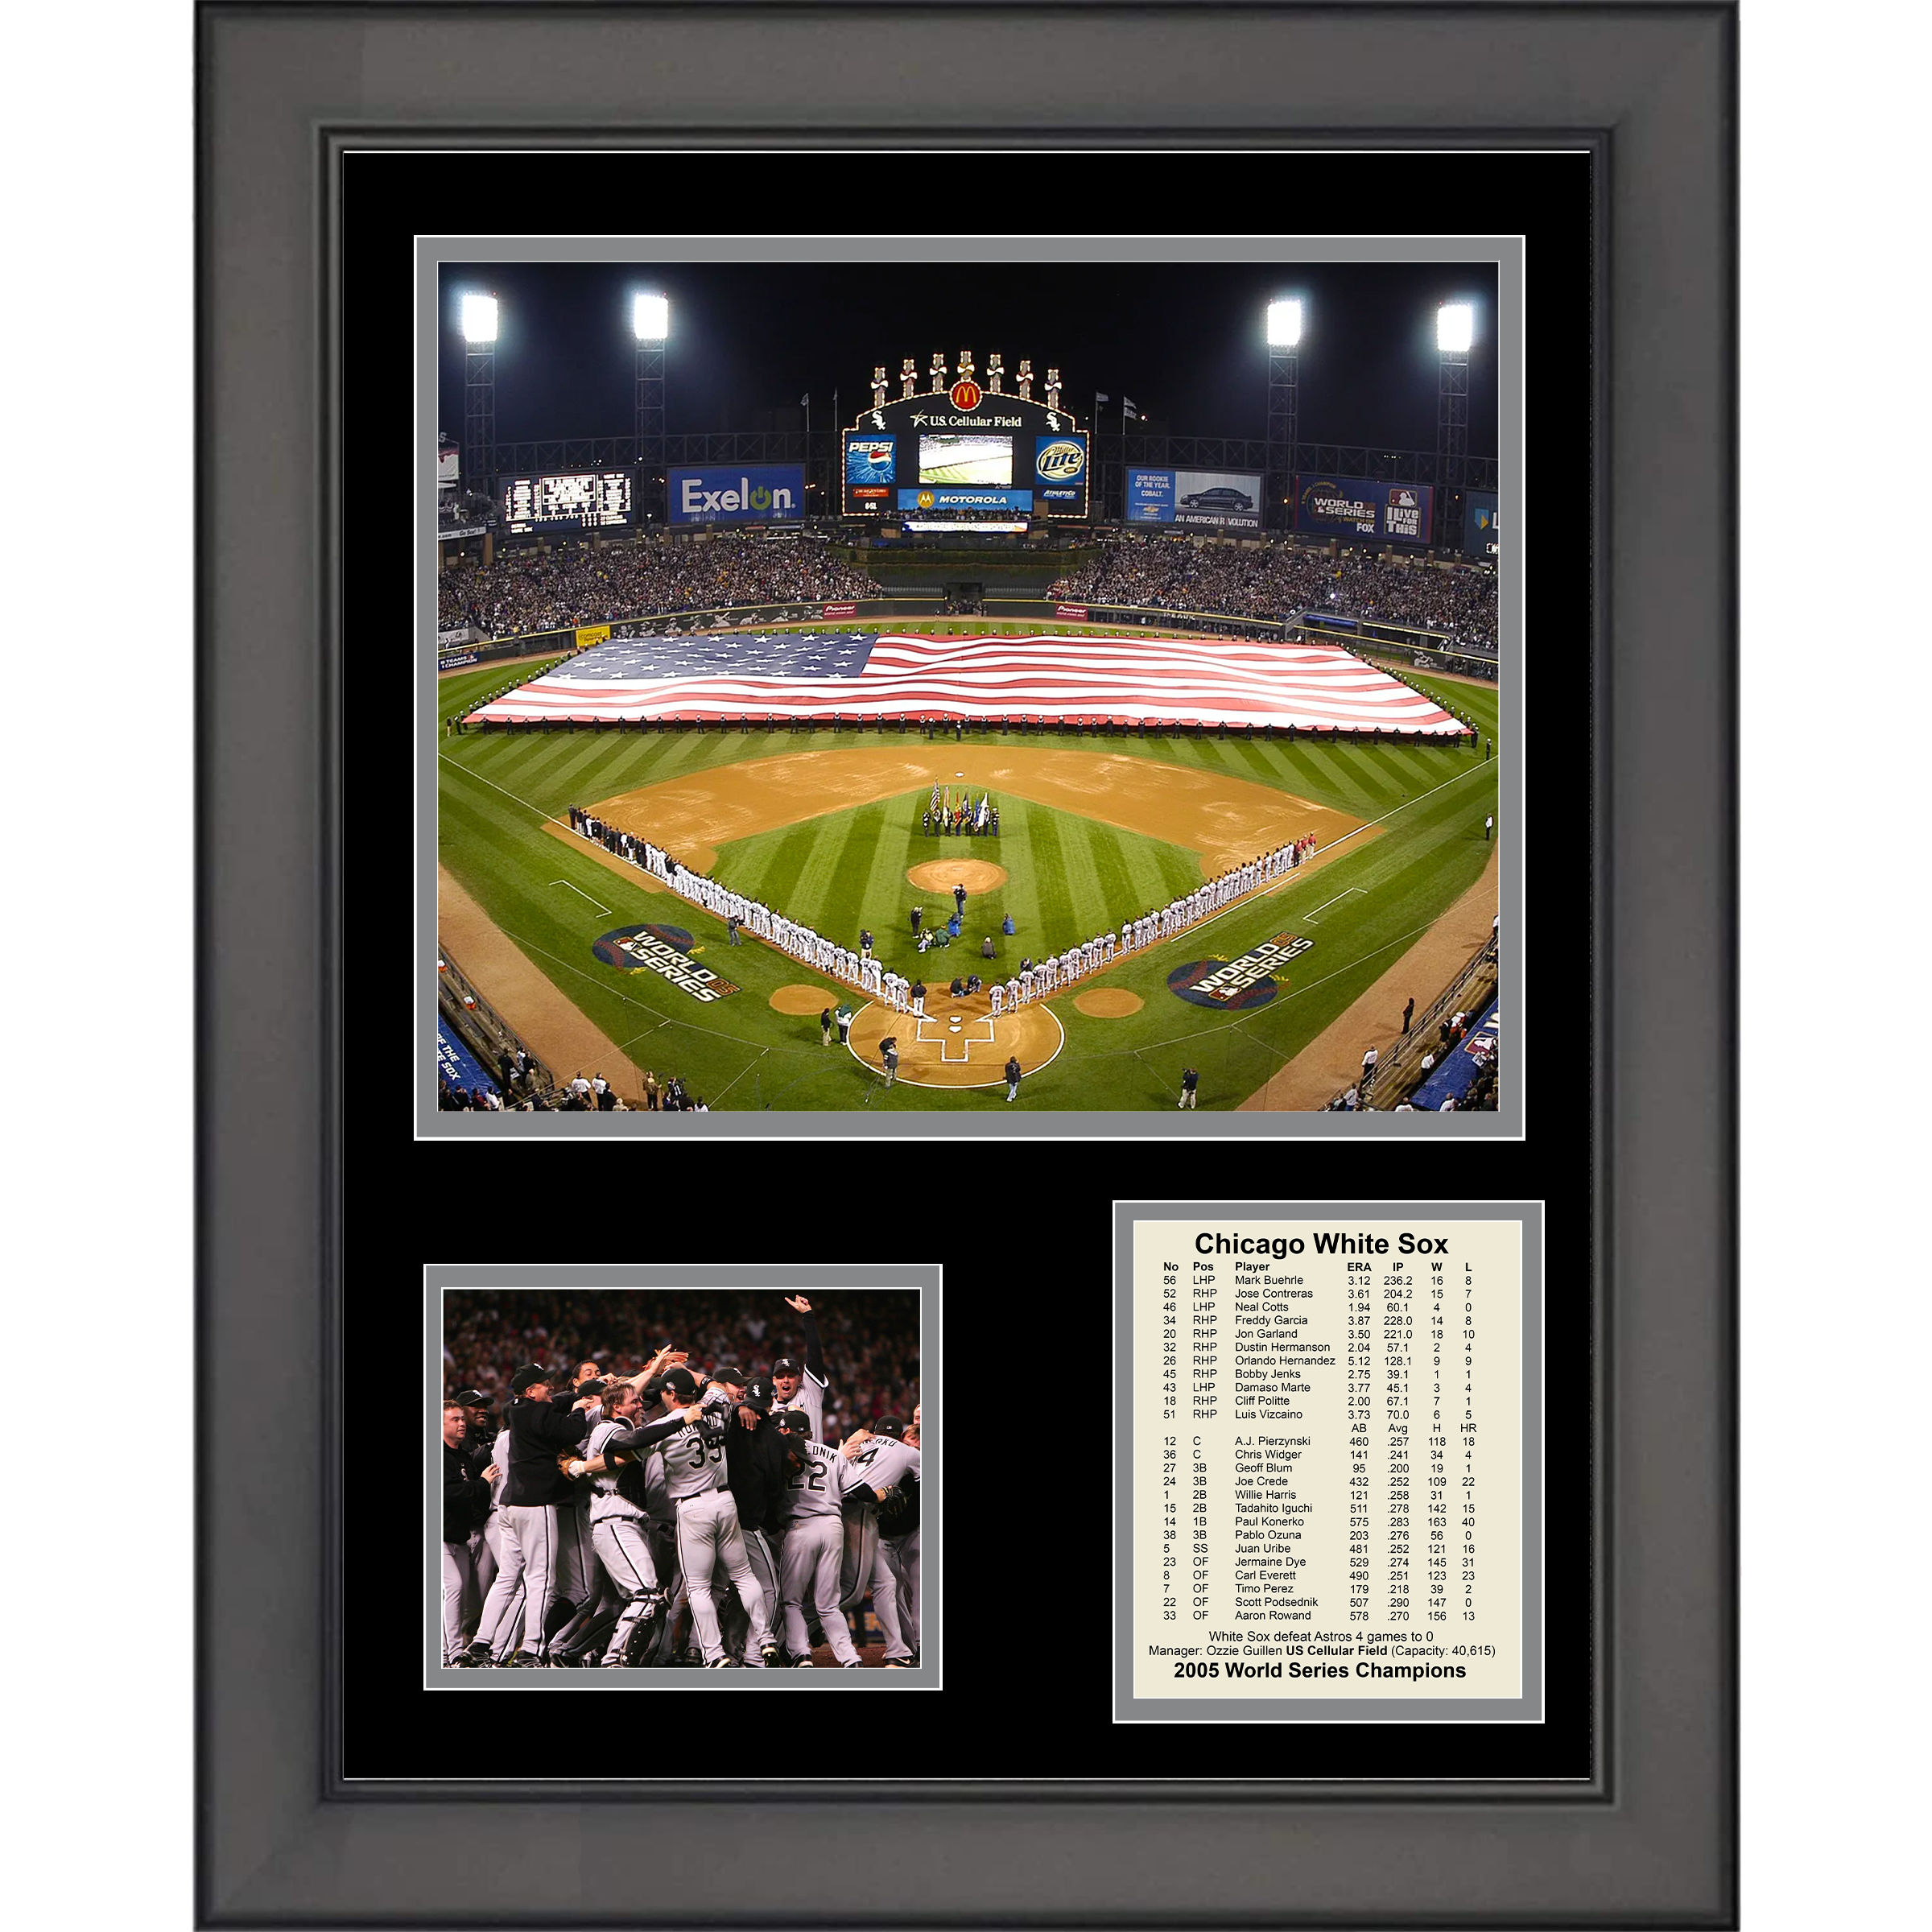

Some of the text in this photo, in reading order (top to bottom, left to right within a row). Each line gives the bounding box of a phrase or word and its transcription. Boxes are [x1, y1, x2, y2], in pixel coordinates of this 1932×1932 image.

[930, 415, 1022, 427] U.S. Cellular Field
[848, 442, 894, 452] PEPSI
[1042, 452, 1081, 472] Lite
[682, 477, 791, 513] Exelon
[939, 495, 1007, 504] MOTOROLA
[1314, 497, 1364, 510] WORLD
[1325, 506, 1375, 519] SERIES
[1174, 514, 1185, 522] AN
[1185, 515, 1218, 525] AMERICAN
[1356, 522, 1375, 533] FOX
[1057, 605, 1087, 613] Pioneer
[445, 658, 477, 668] CHAMPION
[633, 931, 718, 983] WORLD
[1190, 943, 1281, 993] WORLD
[1230, 938, 1315, 989] SERIES
[630, 948, 721, 1002] SERIES
[443, 1044, 460, 1063] THE
[441, 1062, 461, 1080] SOX
[1195, 1232, 1449, 1260] Chicago White Sox
[1163, 1261, 1472, 1274] No Pos Player ERA IP W L
[1163, 1274, 1472, 1286] 56 LHP Mark Buehrle 3.12 236.2 16 8
[1235, 1288, 1314, 1298] Jose Contreras
[1235, 1302, 1289, 1312] Neal Cotts
[1235, 1315, 1308, 1327] Freddy Garcia
[1235, 1328, 1298, 1339] Jon Garland
[1235, 1342, 1331, 1352] Dustin Hermanson
[1235, 1355, 1336, 1365] Orlando Hernandez
[1235, 1368, 1302, 1381] Bobby Jenks
[1235, 1382, 1311, 1393] Damaso Marte
[1235, 1395, 1290, 1406] Cliff Politte
[1235, 1409, 1303, 1419] Luis Vizcaino
[1351, 1422, 1477, 1435] AB Avg H HR
[1234, 1435, 1311, 1448] A.J. Pierzynski
[1235, 1449, 1302, 1462] Chris Widger
[1235, 1463, 1293, 1473] Geoff Blum
[1235, 1476, 1289, 1486] Joe Crede
[1235, 1489, 1297, 1500] Willie Harris
[1234, 1503, 1313, 1516] Tadahito Iguchi
[1235, 1516, 1305, 1526] Paul Konerko
[1235, 1530, 1302, 1540] Pablo Ozuna
[1235, 1543, 1291, 1554] Juan Uribe
[1235, 1556, 1307, 1569] Jermaine Dye
[1235, 1570, 1297, 1580] Carl Everett
[1234, 1583, 1294, 1594] Timo Perez
[1235, 1596, 1319, 1607] Scott Podsednik
[1234, 1610, 1311, 1620] Aaron Rowand
[1208, 1630, 1434, 1645] White Sox defeat Astros 4 games to 0
[1149, 1645, 1496, 1659] Manager: Ozzie Guillen US Cellular Field (Capacity: 40,615)
[1174, 1662, 1467, 1682] 2005 World Series Champions
